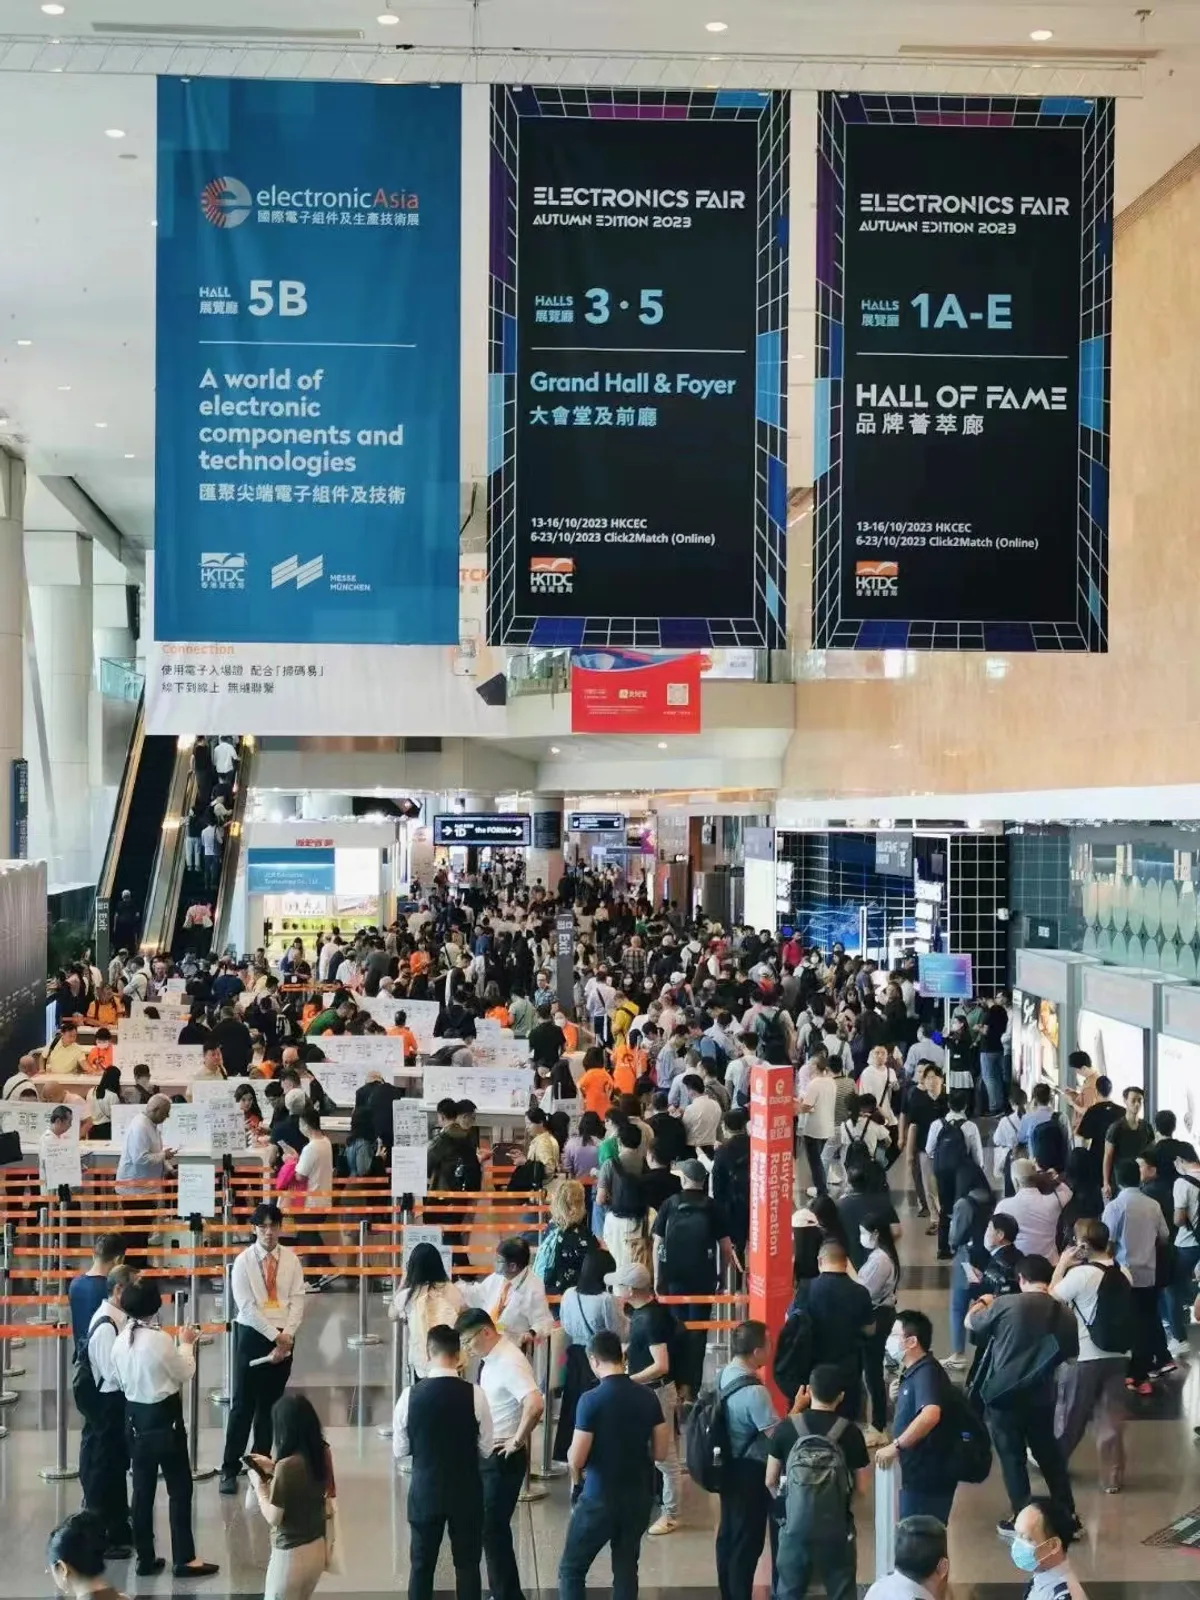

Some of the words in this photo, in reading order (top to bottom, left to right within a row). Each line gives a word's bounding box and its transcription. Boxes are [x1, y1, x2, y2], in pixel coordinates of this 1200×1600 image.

[256, 185, 418, 210] electronicAsia
[534, 186, 689, 208] ELECTRONICS
[696, 190, 746, 209] FAIR
[860, 193, 1014, 214] ELECTRONICS
[1020, 196, 1070, 216] FAIR
[257, 210, 420, 226] 國際電子組件及生產技術展
[532, 214, 592, 226] AUTUMN
[596, 215, 648, 228] EDITION
[653, 216, 692, 228] 2023
[859, 220, 918, 232] AUTUMN
[922, 222, 974, 234] EDITION
[978, 222, 1016, 234] 2023
[199, 287, 231, 298] HALL
[248, 280, 308, 316] 5B
[535, 296, 574, 307] HALLS
[862, 300, 900, 310] HALLS
[910, 294, 1012, 329] 1A-E
[198, 368, 218, 389] A
[224, 368, 290, 390] world
[297, 369, 324, 390] of
[530, 372, 599, 392] Grand
[605, 372, 648, 394] Hall
[654, 374, 672, 394] &
[676, 374, 736, 400] Foyer
[199, 395, 321, 418] electronic
[856, 384, 928, 408] HALL
[936, 386, 978, 409] OF
[986, 386, 1068, 410] FAME
[529, 406, 658, 426] 大會堂及前廳
[856, 413, 984, 436] 品牌薈萃廊
[199, 425, 350, 448] components
[357, 424, 404, 446] and
[198, 450, 356, 477] technologies
[199, 483, 406, 504] 匯聚尖端電子組件及技術
[531, 517, 608, 529] 13-16/10/2023
[610, 518, 648, 529] HKCEC
[856, 522, 932, 534] 13-16/10/2023
[936, 522, 972, 533] HKCEC
[530, 532, 602, 544] 6-23/10/2023
[604, 532, 668, 544] Click2Match
[671, 534, 716, 546] (Online)
[856, 536, 926, 548] 6-23/10/2023
[929, 536, 992, 548] Click2Match
[996, 538, 1039, 550] (Online)
[201, 568, 244, 582] HKTDC
[330, 574, 356, 582] MESSE
[530, 572, 573, 586] HKTDC
[856, 576, 898, 590] HKTDC
[558, 934, 570, 956] Exit
[780, 1151, 792, 1200] Buyer
[768, 1152, 780, 1256] Registration
